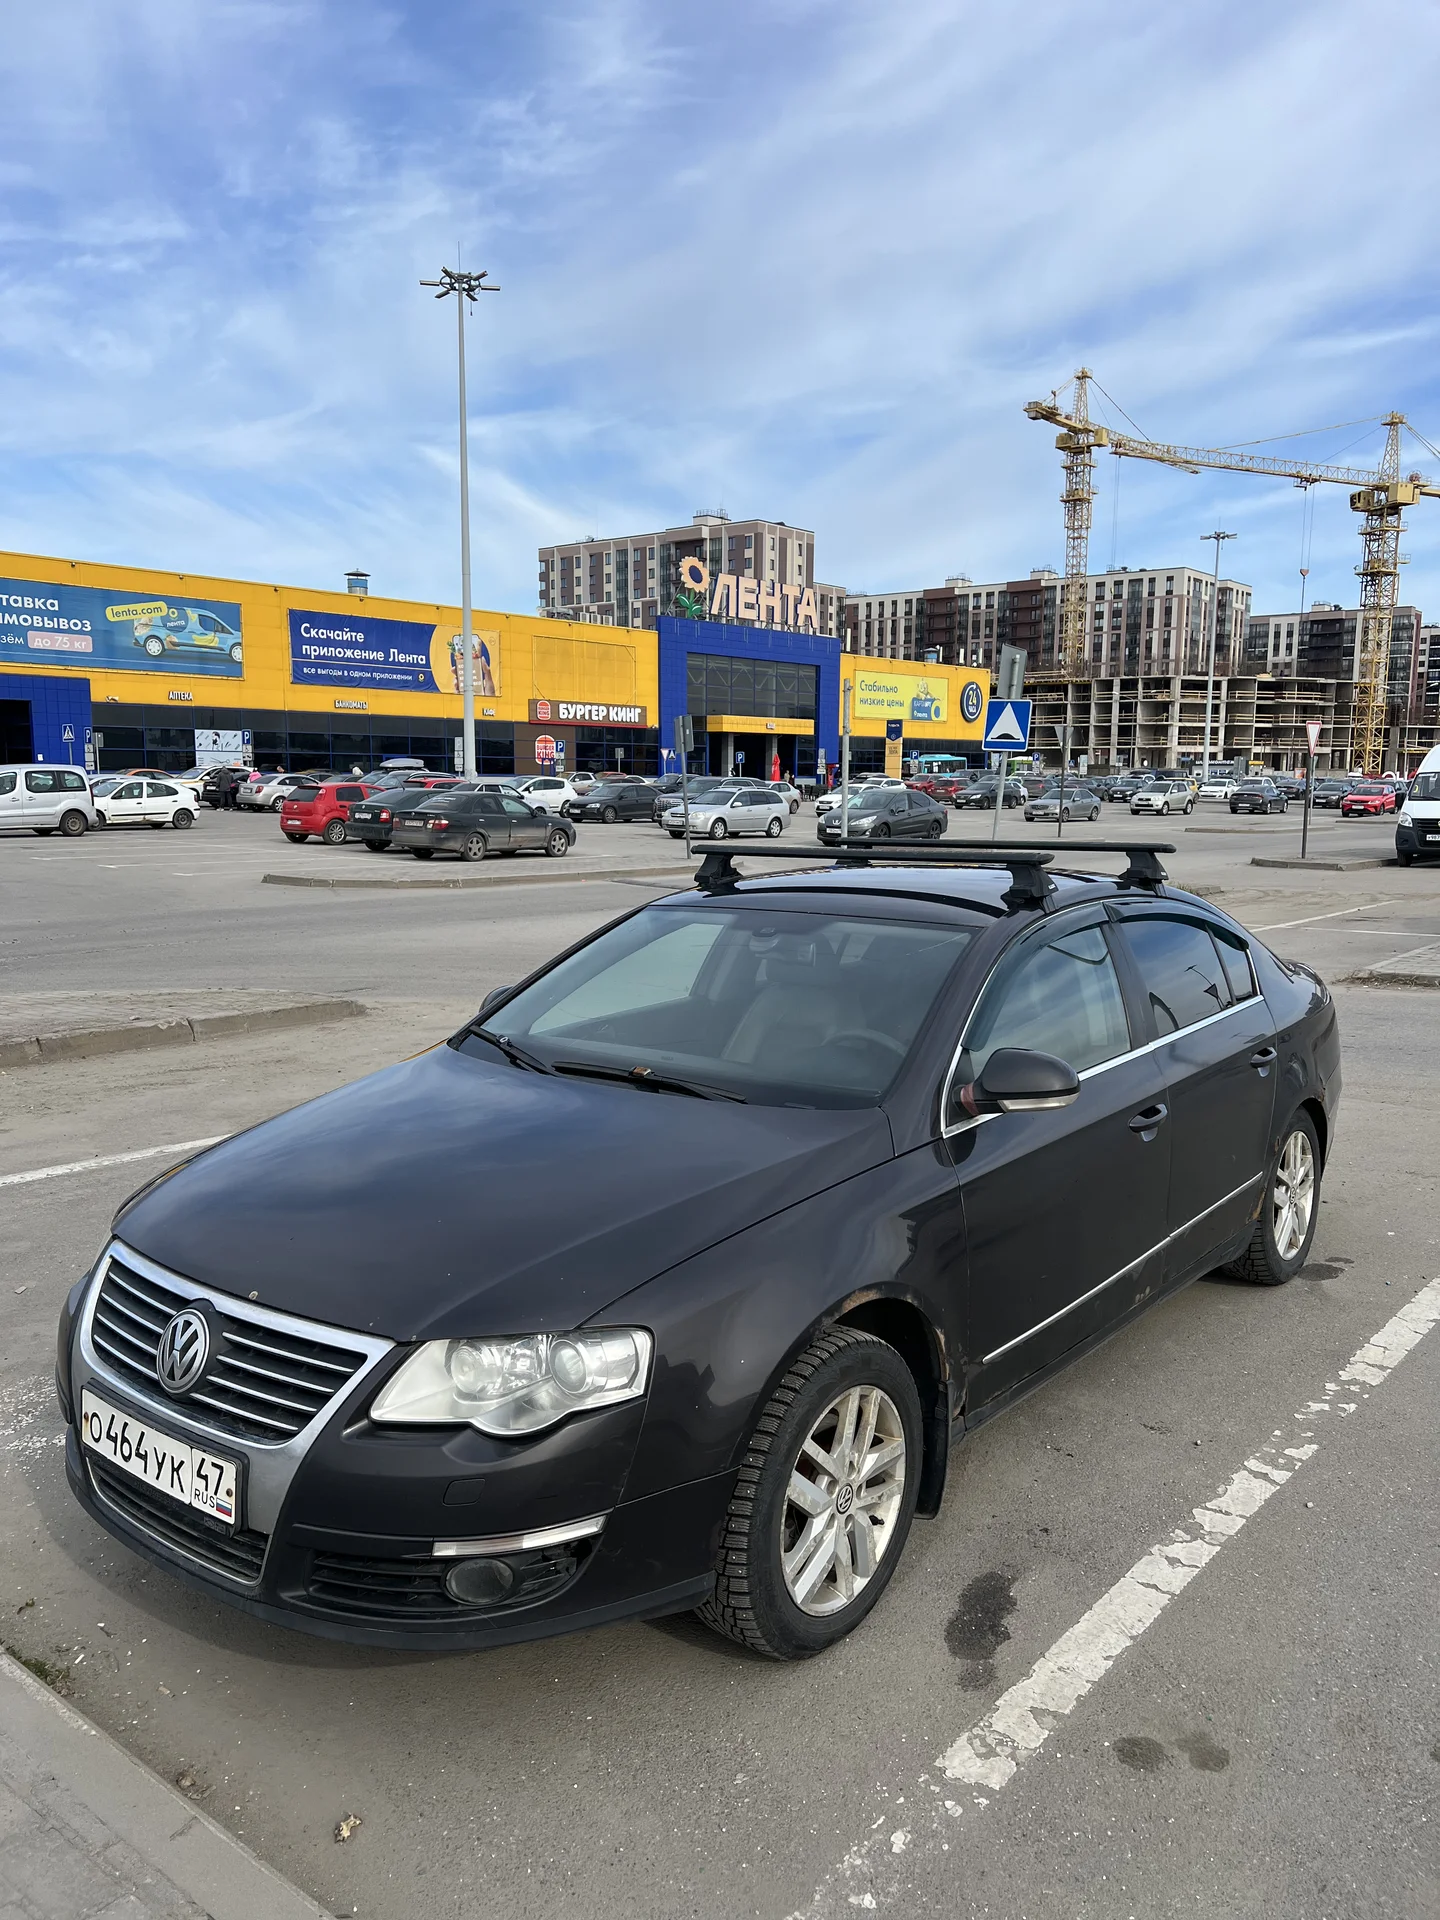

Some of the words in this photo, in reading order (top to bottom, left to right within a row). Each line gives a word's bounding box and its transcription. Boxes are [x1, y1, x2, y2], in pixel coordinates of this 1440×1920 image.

[709, 573, 818, 629] ЛЕНТА
[111, 605, 163, 618] lenta.com
[0, 612, 92, 632] мовывоз
[300, 623, 365, 642] Скачайте
[34, 638, 51, 648] до
[54, 636, 70, 648] 75
[74, 640, 87, 649] кг
[302, 643, 385, 661] приложение
[388, 649, 426, 665] Лента
[303, 667, 316, 675] все
[317, 667, 343, 677] выгоды
[350, 670, 372, 678] одном
[372, 671, 413, 681] приложении
[859, 680, 899, 693] Стабильно
[168, 691, 193, 701] АПТЕКА
[859, 697, 885, 706] низкие
[886, 698, 905, 708] цены
[968, 690, 977, 705] 24
[334, 699, 369, 710] БАНКОМАТЫ
[558, 703, 608, 721] БУРГЕР
[608, 706, 642, 723] КИНГ
[536, 751, 555, 759] KING
[195, 1456, 224, 1497] 47
[194, 1487, 216, 1509] RUS
